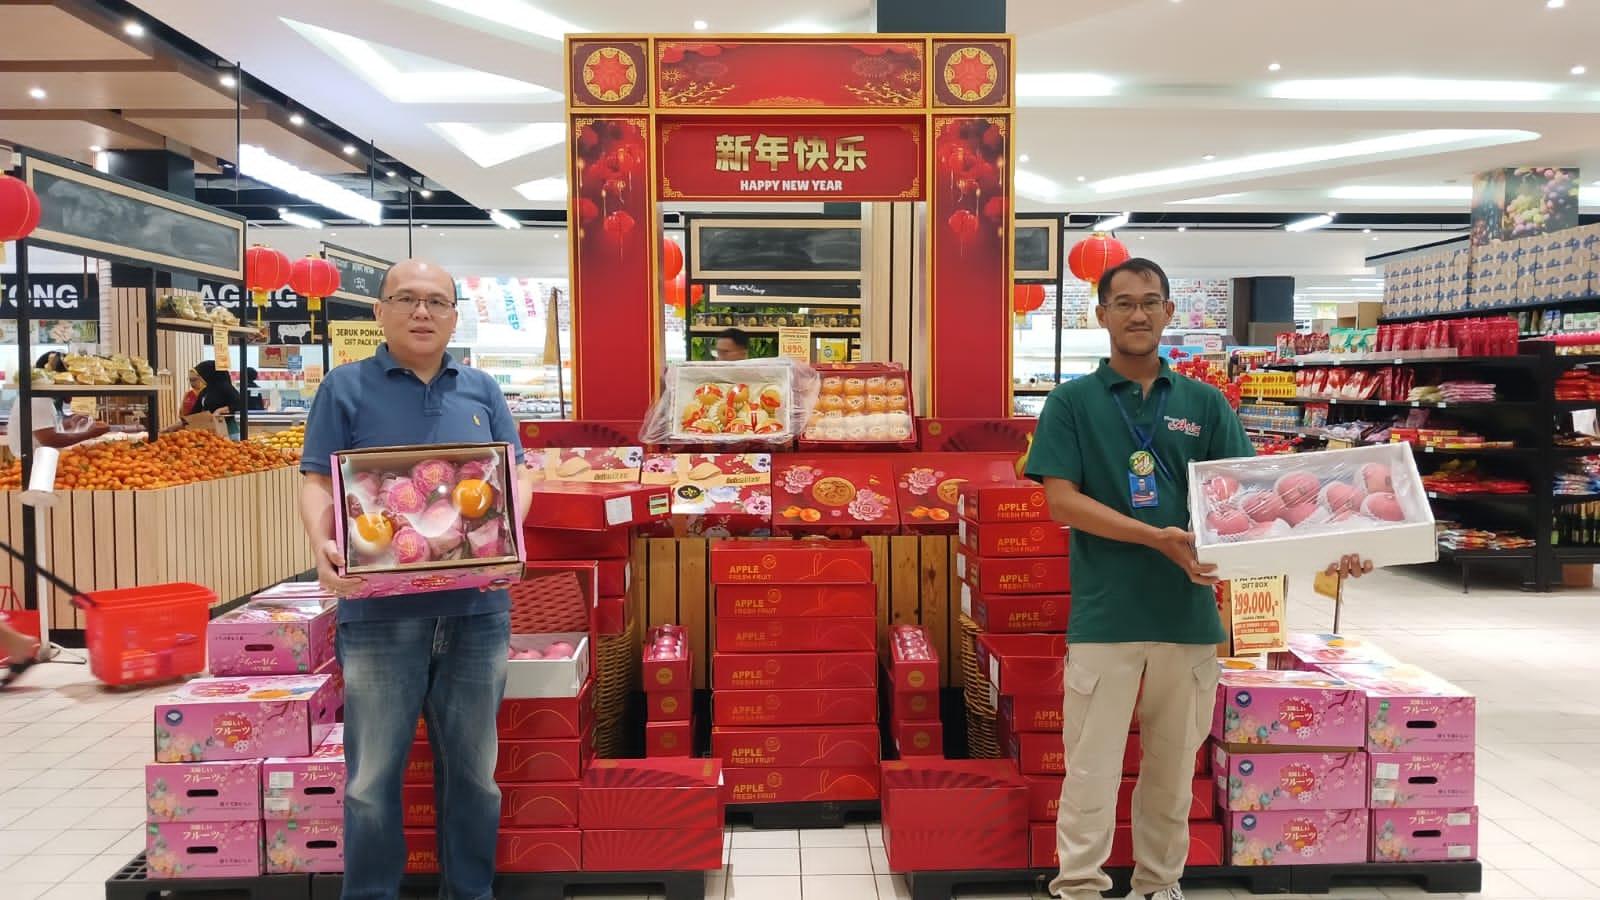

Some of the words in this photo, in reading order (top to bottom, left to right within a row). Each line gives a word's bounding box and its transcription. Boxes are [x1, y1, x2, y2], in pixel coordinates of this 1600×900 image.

[715, 133, 867, 172] 新年快乐
[740, 180, 780, 191] HAPPY
[782, 180, 809, 191] NEW
[811, 180, 843, 191] YEAR
[998, 503, 1028, 511] APPLE
[997, 537, 1028, 546] APPLE
[729, 565, 760, 574] APPLE
[1000, 574, 1030, 583] APPLE
[735, 600, 765, 608] APPLE
[732, 671, 762, 679] APPLE
[1402, 706, 1440, 714] フルーツ
[1034, 711, 1064, 720] APPL
[1280, 712, 1313, 720] フルーツ
[215, 727, 250, 737] フルーツ
[732, 748, 762, 757] APPLE
[1404, 762, 1440, 771] フルーツ
[184, 774, 220, 783] フルーツ
[300, 771, 336, 781] フルーツ
[1281, 778, 1314, 786] フルーツ
[733, 784, 764, 793] APPLE
[408, 804, 437, 814] APPL
[1408, 816, 1444, 825] フルーツ
[184, 831, 220, 841] フルーツ
[1284, 831, 1318, 840] フルーツ
[408, 851, 437, 861] APPL
